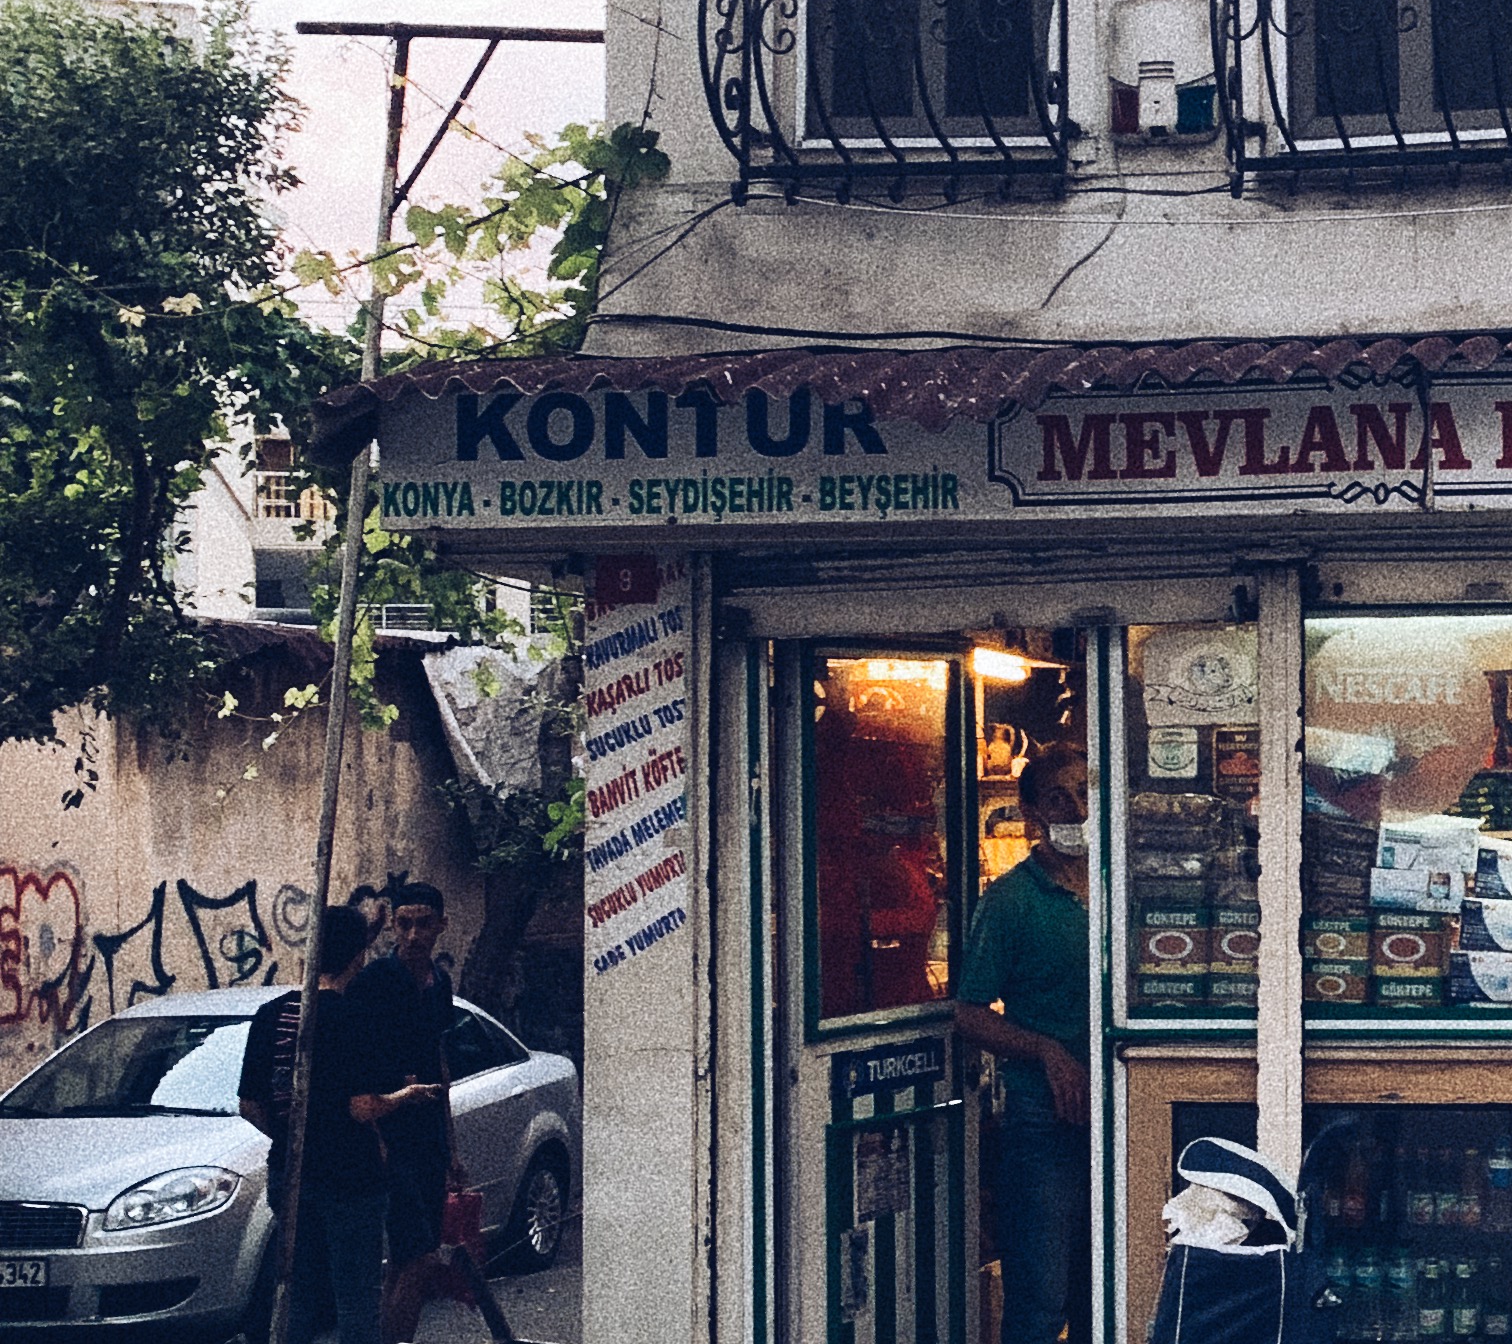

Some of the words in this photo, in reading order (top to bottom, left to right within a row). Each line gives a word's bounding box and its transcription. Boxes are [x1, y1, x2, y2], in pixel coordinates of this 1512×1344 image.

[456, 383, 889, 462] KONTUR
[1036, 401, 1471, 481] MEVLANA
[382, 481, 476, 518] KONYA
[499, 479, 604, 517] BOZKIR
[628, 467, 794, 522] SEYDİŞEHİR
[819, 464, 960, 519] BEYŞEHİR
[586, 714, 653, 761] SUCUKLU
[867, 1050, 939, 1082] TURKCELL
